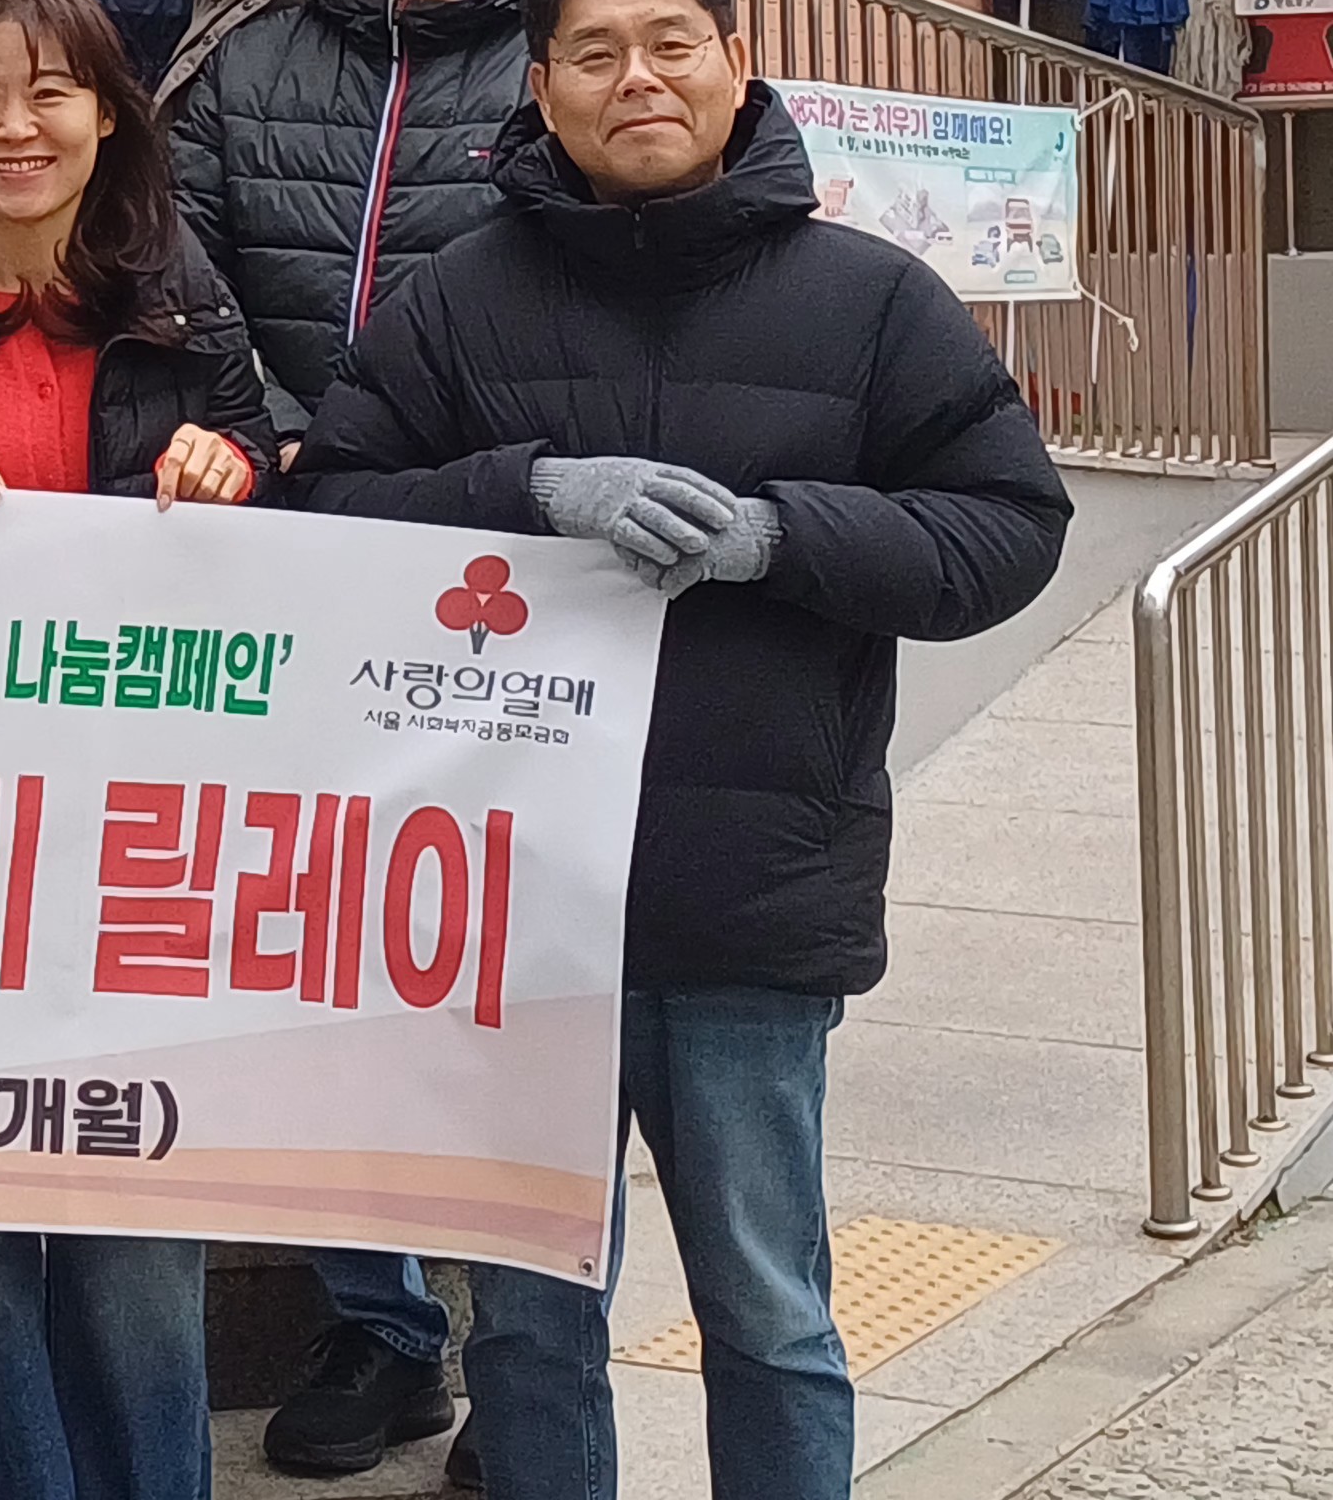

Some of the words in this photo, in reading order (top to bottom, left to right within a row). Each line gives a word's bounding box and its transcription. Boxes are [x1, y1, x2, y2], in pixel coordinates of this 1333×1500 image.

[850, 100, 869, 133] 눈
[349, 659, 596, 718] 사랑의열매
[364, 709, 401, 731] 서울
[92, 780, 514, 1030] 릴레이
